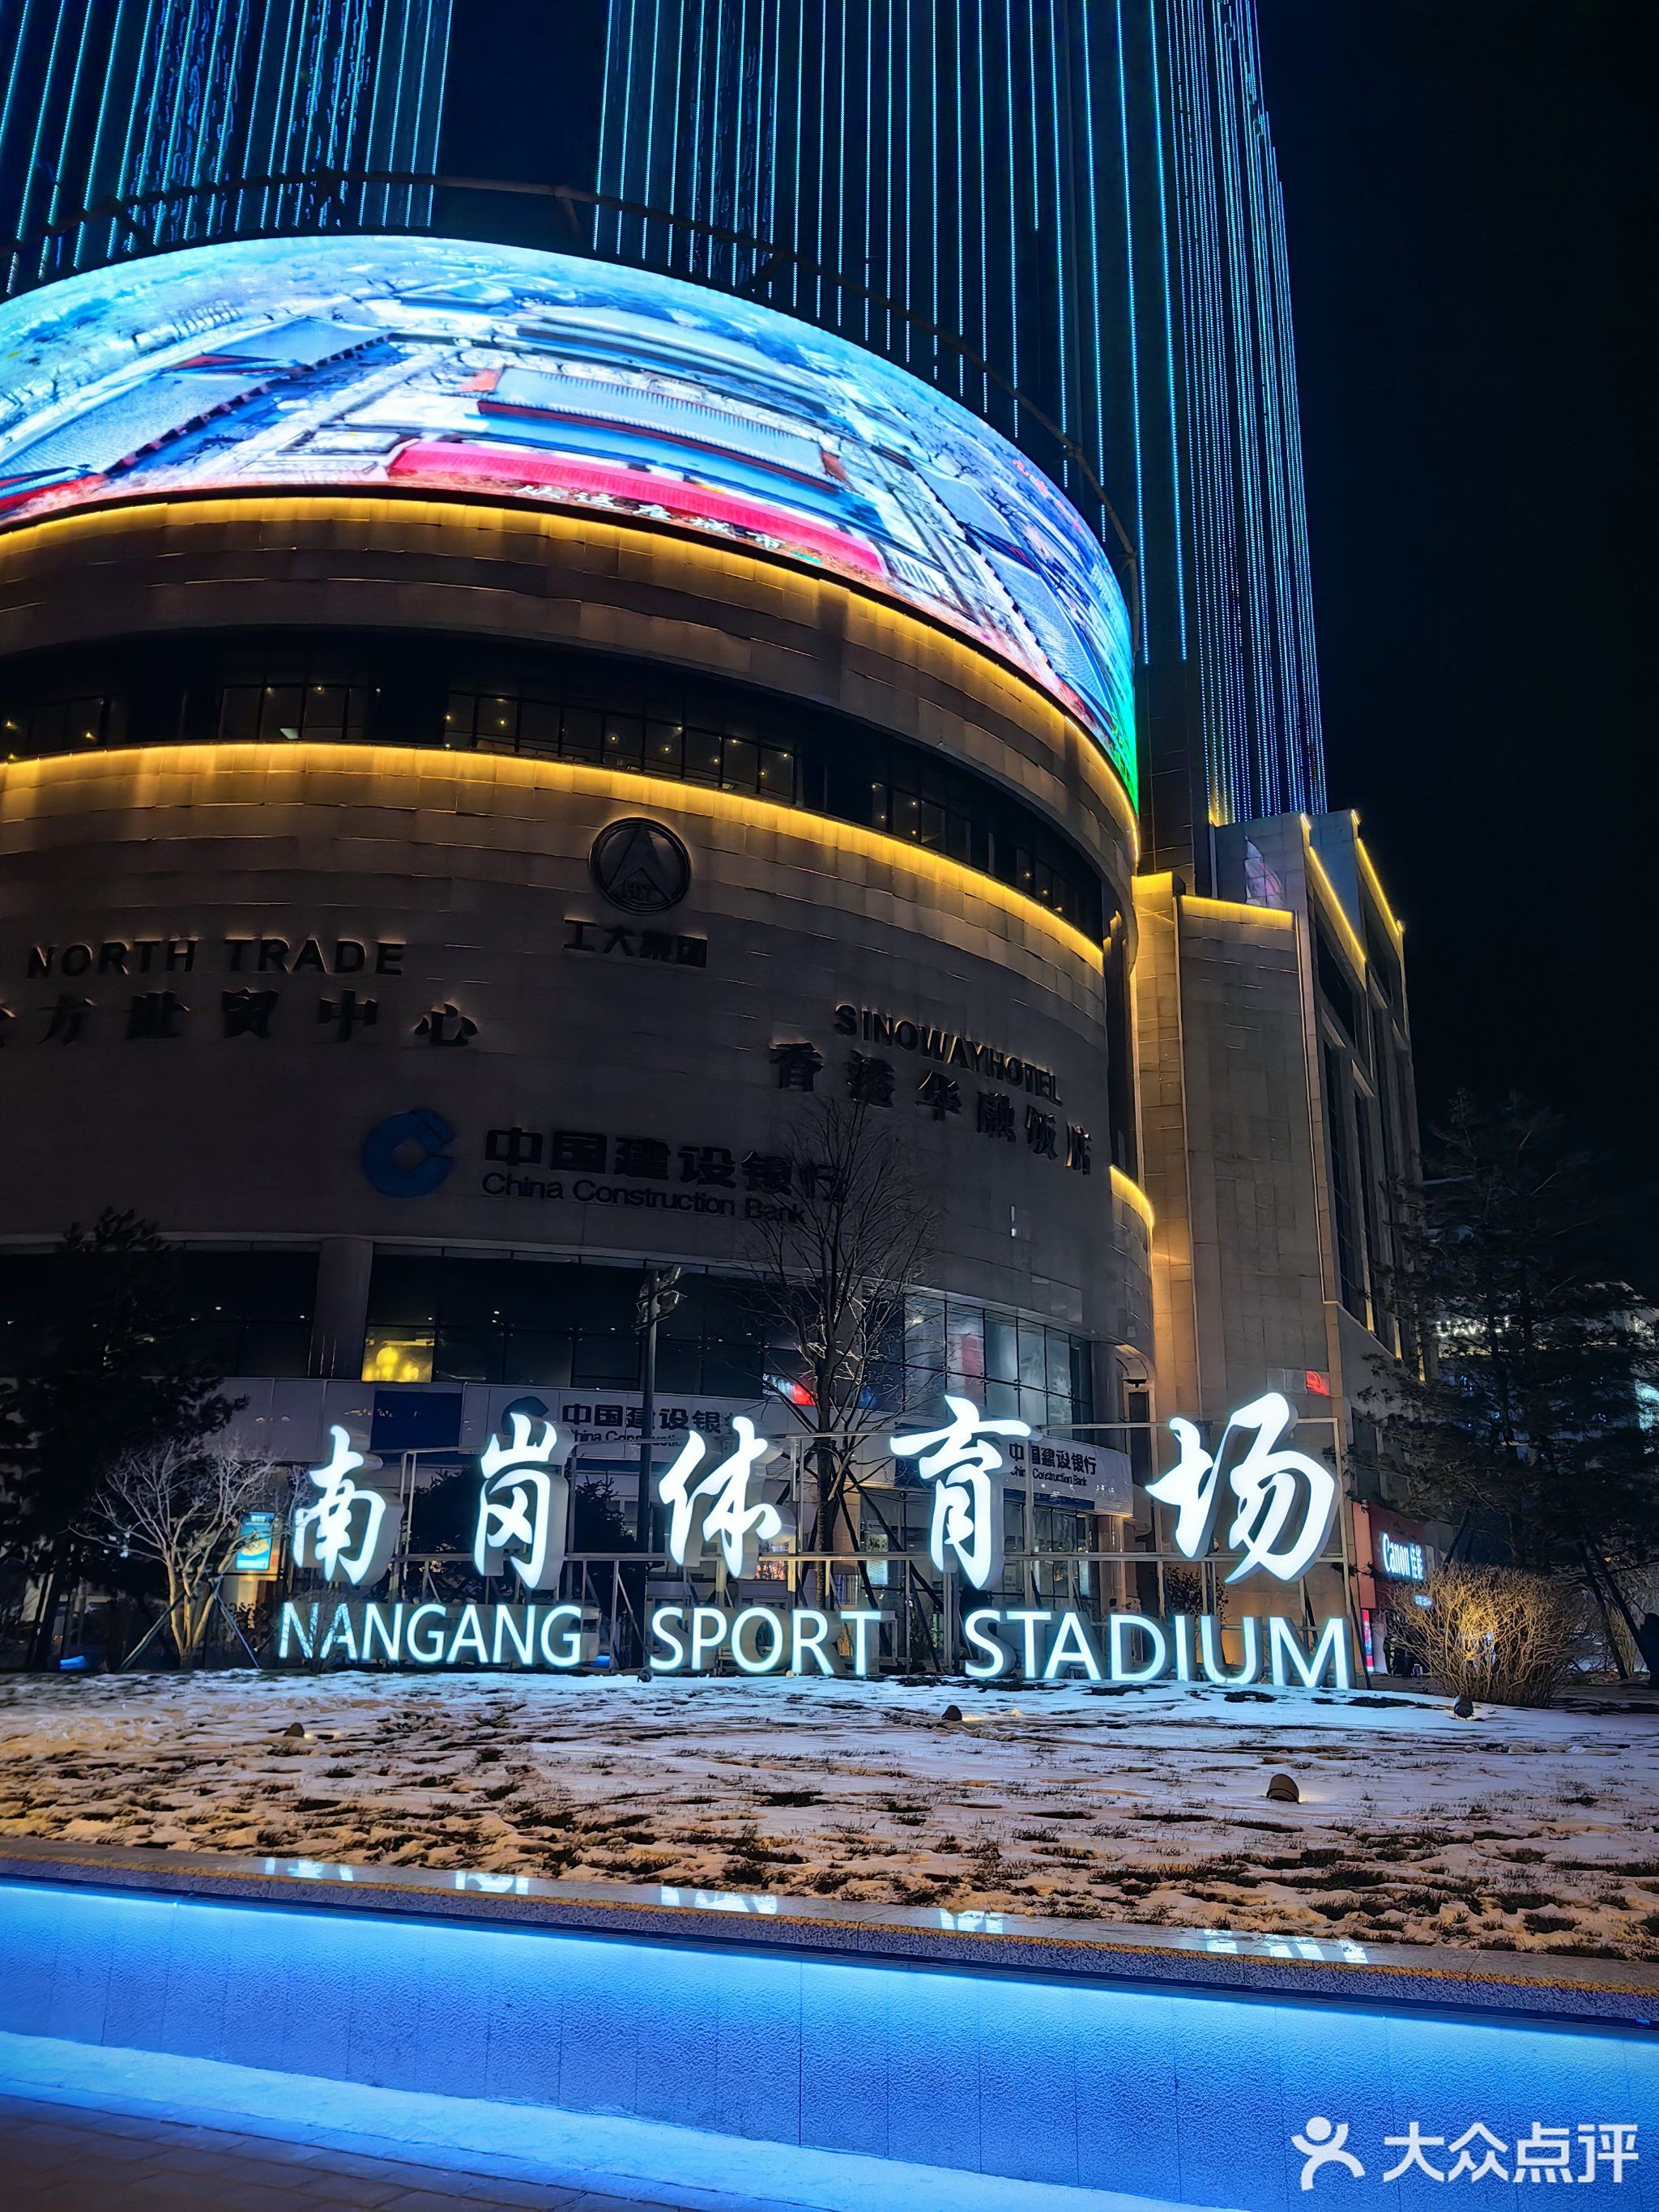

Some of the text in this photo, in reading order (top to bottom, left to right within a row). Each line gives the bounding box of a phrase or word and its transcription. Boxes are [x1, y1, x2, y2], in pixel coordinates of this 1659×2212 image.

[27, 936, 407, 978] NORTH TRADE
[483, 1172, 805, 1224] China Construction Bank
[292, 1389, 1338, 1589] 南岗体育场
[1383, 1532, 1410, 1576] Canon
[279, 1601, 582, 1667] NANGANG
[650, 1606, 881, 1675] SPORT
[965, 1609, 1350, 1689] STADIUM
